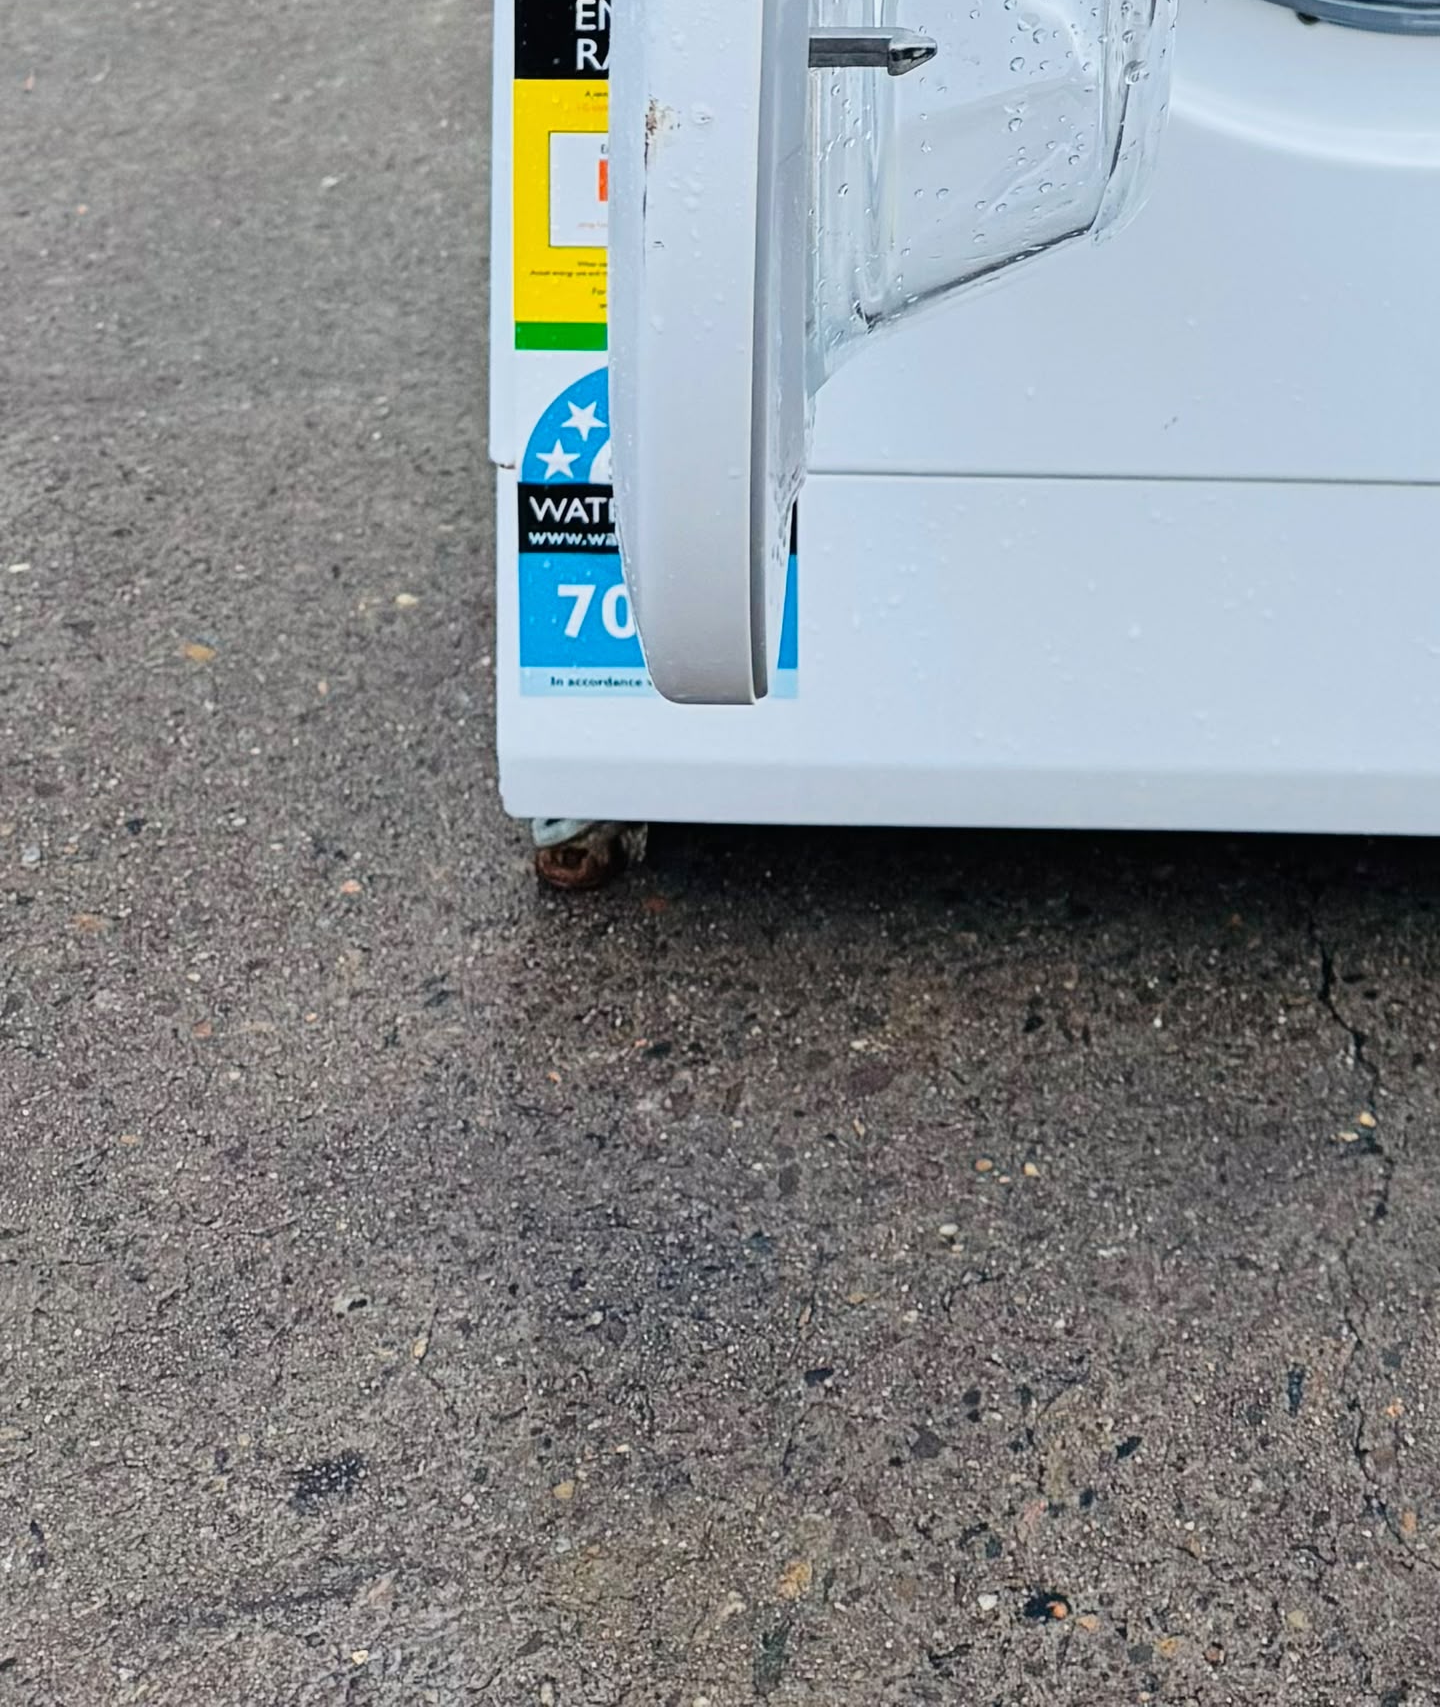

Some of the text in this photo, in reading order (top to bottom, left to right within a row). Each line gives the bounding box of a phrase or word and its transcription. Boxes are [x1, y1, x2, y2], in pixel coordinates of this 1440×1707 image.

[557, 583, 638, 640] 70
[550, 675, 563, 686] In
[568, 676, 642, 687] accordance
